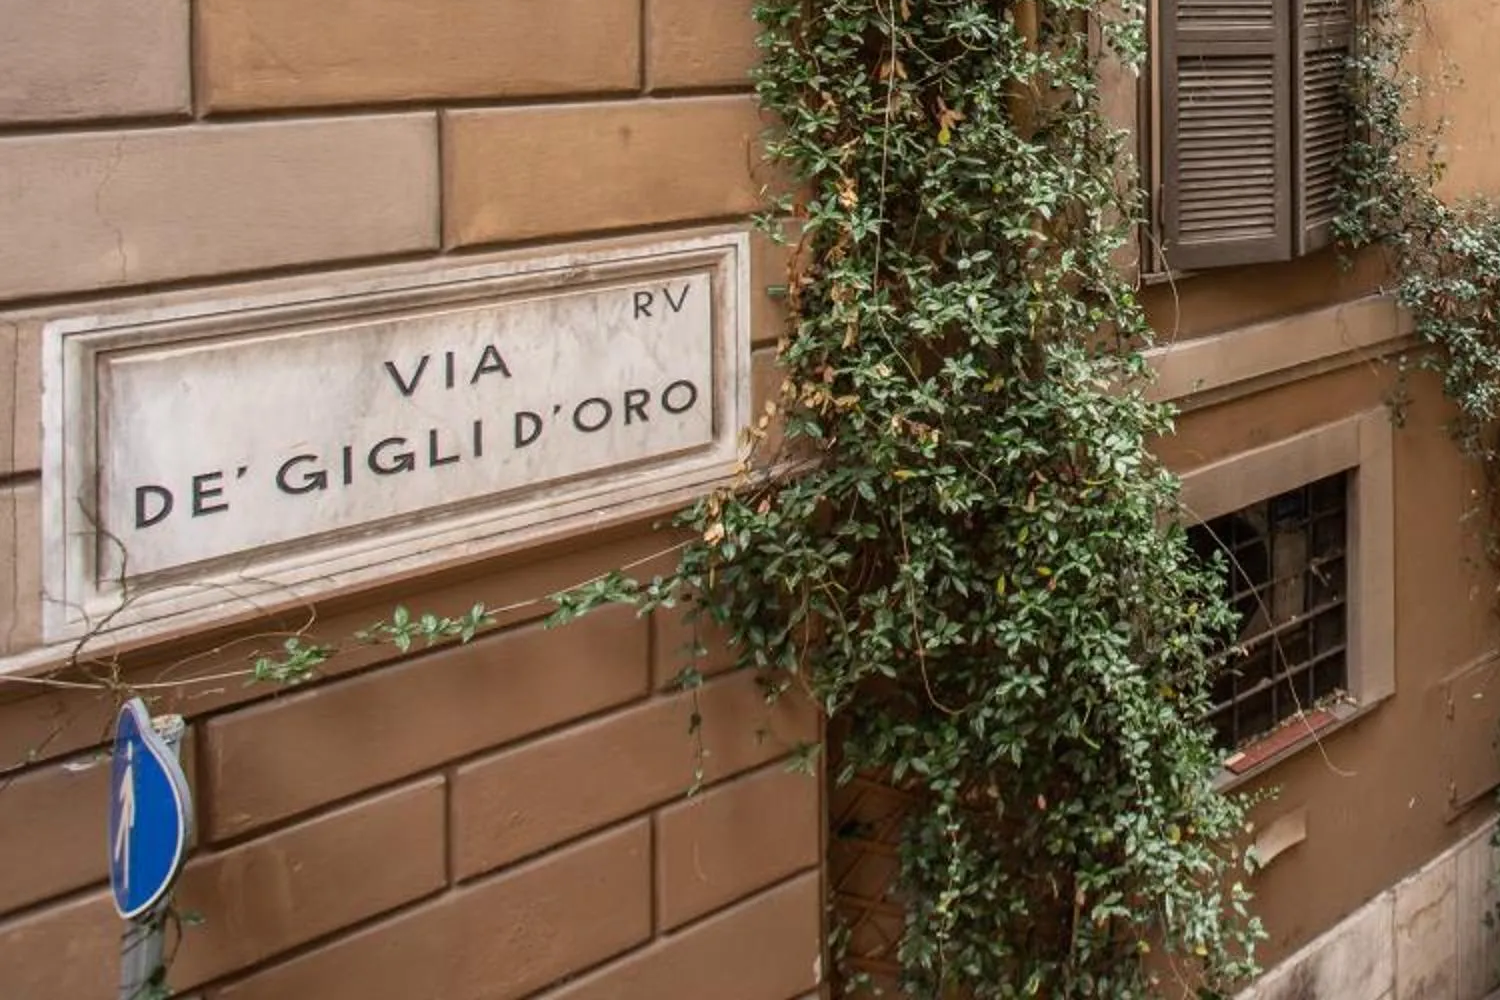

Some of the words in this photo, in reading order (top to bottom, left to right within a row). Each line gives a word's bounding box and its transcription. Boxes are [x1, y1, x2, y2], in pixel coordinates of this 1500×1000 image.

[633, 284, 691, 319] RV
[384, 344, 512, 397] VIA
[276, 420, 484, 494] GIGLI
[514, 379, 698, 449] D'ORO
